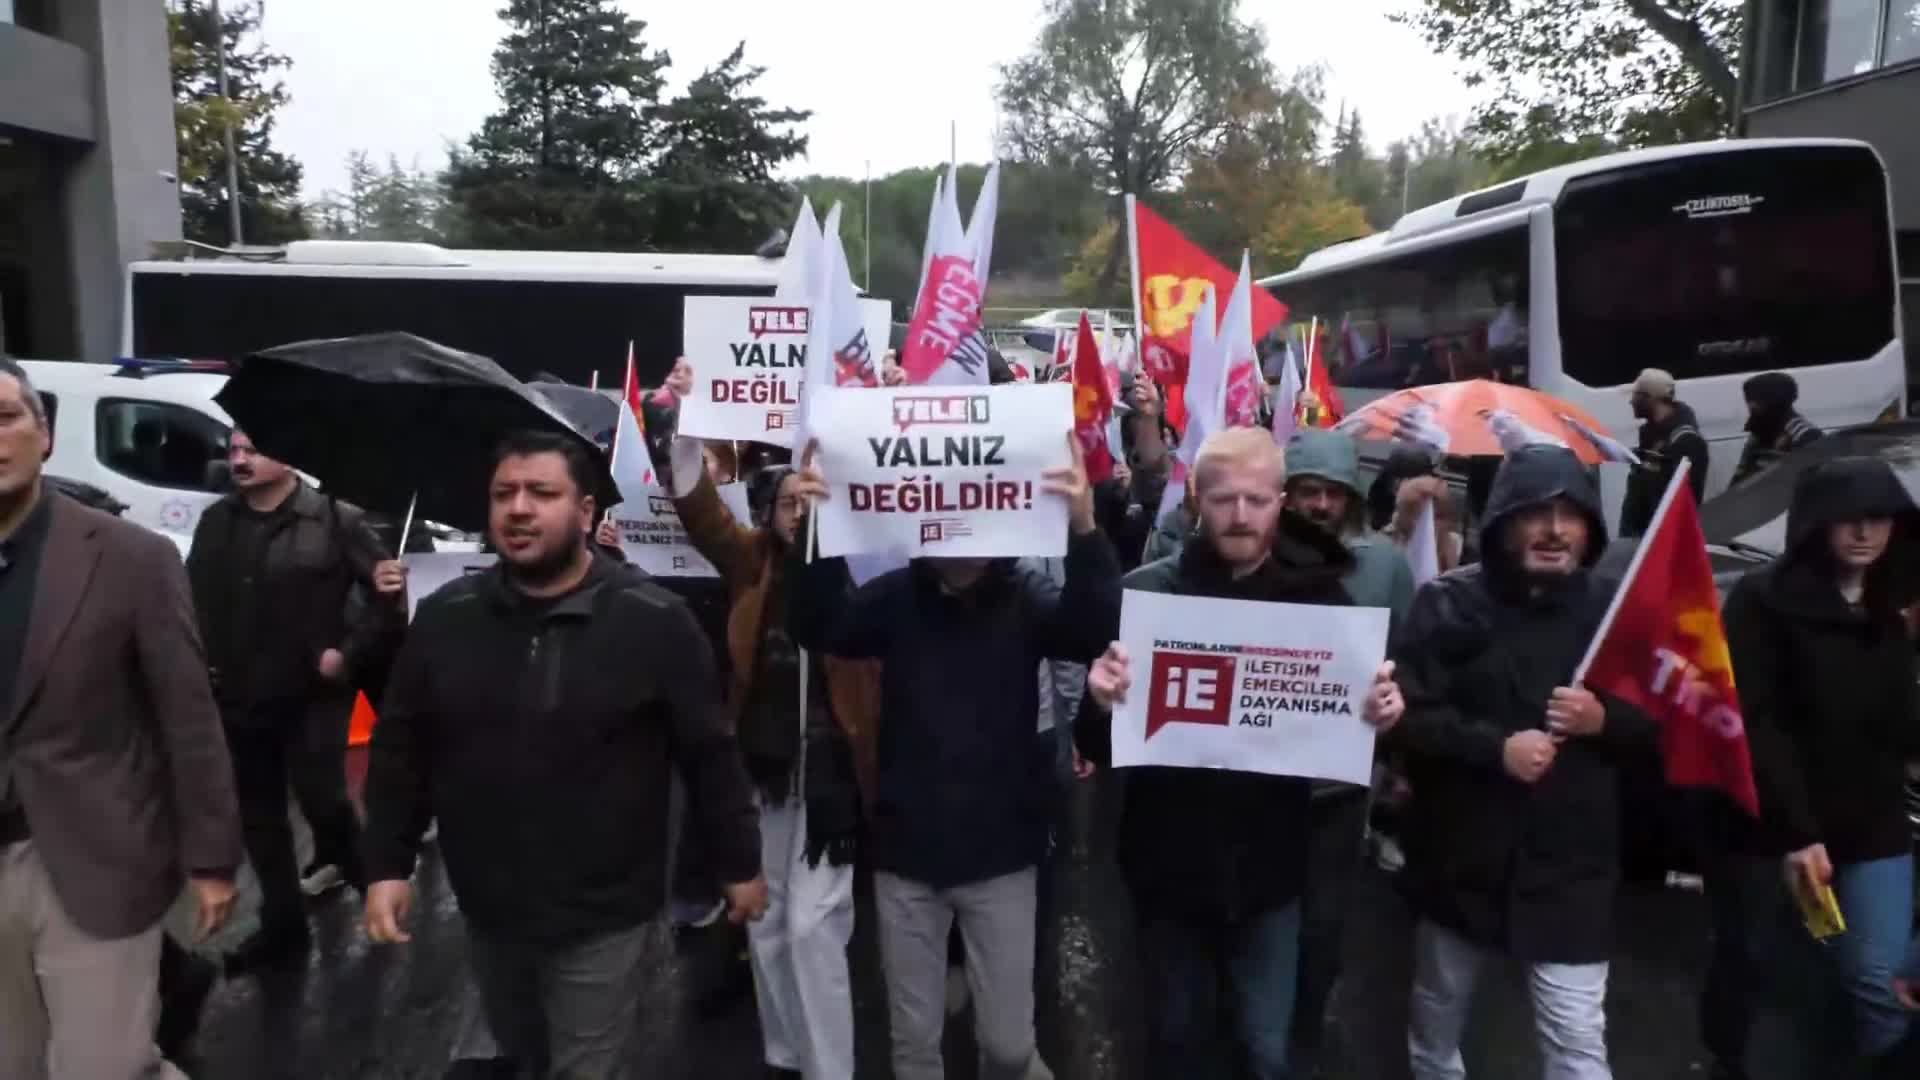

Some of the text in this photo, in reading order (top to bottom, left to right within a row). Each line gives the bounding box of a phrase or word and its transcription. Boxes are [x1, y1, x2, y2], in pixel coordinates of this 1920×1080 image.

[730, 343, 807, 369] YALN
[711, 374, 802, 404] DEĞİL
[868, 436, 1005, 467] YALNIZ
[849, 473, 1033, 512] DEĞİLDİR!
[1239, 711, 1273, 729] AĞI
